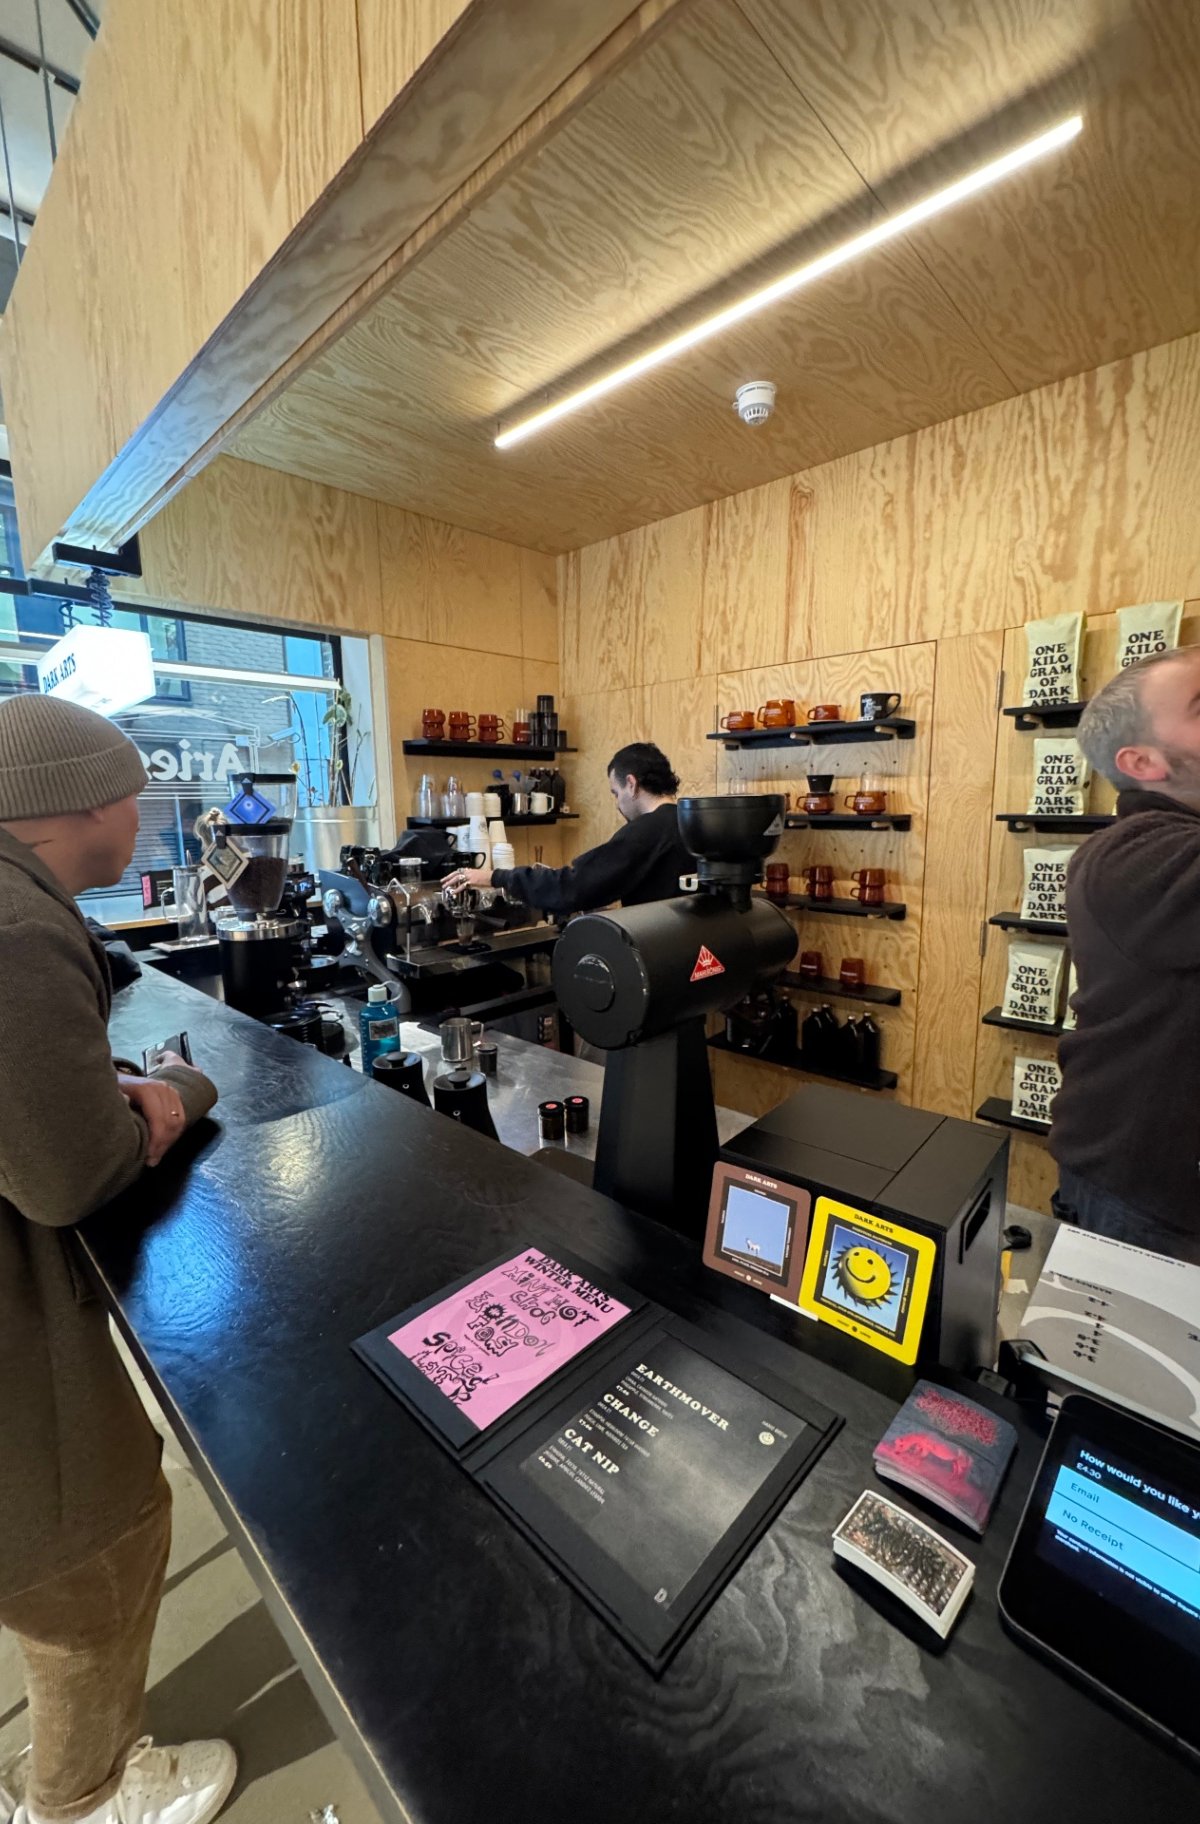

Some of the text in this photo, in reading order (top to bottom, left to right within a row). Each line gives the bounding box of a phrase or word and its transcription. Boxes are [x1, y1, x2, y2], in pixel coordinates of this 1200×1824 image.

[1128, 630, 1164, 643] ONE
[1035, 643, 1066, 655] ONE
[1125, 641, 1167, 656] KILO
[1032, 654, 1069, 667] KILO
[43, 653, 77, 693] DARK ARTS
[1030, 664, 1072, 678] GRAM
[1040, 676, 1059, 687] OF
[1029, 686, 1071, 698] DARK
[1031, 696, 1069, 706] ARTS
[1044, 755, 1074, 764] ONE
[1040, 765, 1075, 774] KILO
[1036, 775, 1078, 785] GRAM
[1045, 786, 1064, 795] OF
[1035, 796, 1075, 805] DARK
[1035, 806, 1074, 814] ARTS
[1034, 863, 1064, 872] ONE
[1031, 873, 1066, 882] KILO
[1038, 893, 1057, 902] OF
[1027, 901, 1066, 912] DARK
[1029, 911, 1067, 920] ARTS
[1018, 965, 1047, 977] ONE
[1015, 974, 1048, 986] KILO
[1011, 982, 1051, 996] GRAM
[1020, 994, 1039, 1004] OF
[1009, 999, 1049, 1014] DARK
[1011, 1010, 1047, 1021] ARTS
[1027, 1063, 1056, 1075] ONE
[1024, 1072, 1058, 1085] KILO
[1030, 1093, 1049, 1103] OF
[745, 1173, 778, 1189] DARK ARTS
[854, 1213, 894, 1234] DARK ARTS
[525, 1256, 615, 1313] WINTER MENU
[539, 1256, 611, 1302] DARK ARTS
[636, 1363, 730, 1431] EARTHMOVER
[603, 1393, 659, 1437] CHANGE
[564, 1428, 594, 1453] CAT
[592, 1451, 620, 1474] NIP
[1076, 1462, 1102, 1480] £4.30
[1079, 1450, 1106, 1469] How
[1106, 1464, 1141, 1488] would
[1143, 1484, 1166, 1501] you
[1168, 1495, 1191, 1514] like
[1071, 1482, 1100, 1503] Email
[1062, 1509, 1124, 1551] No Receipt
